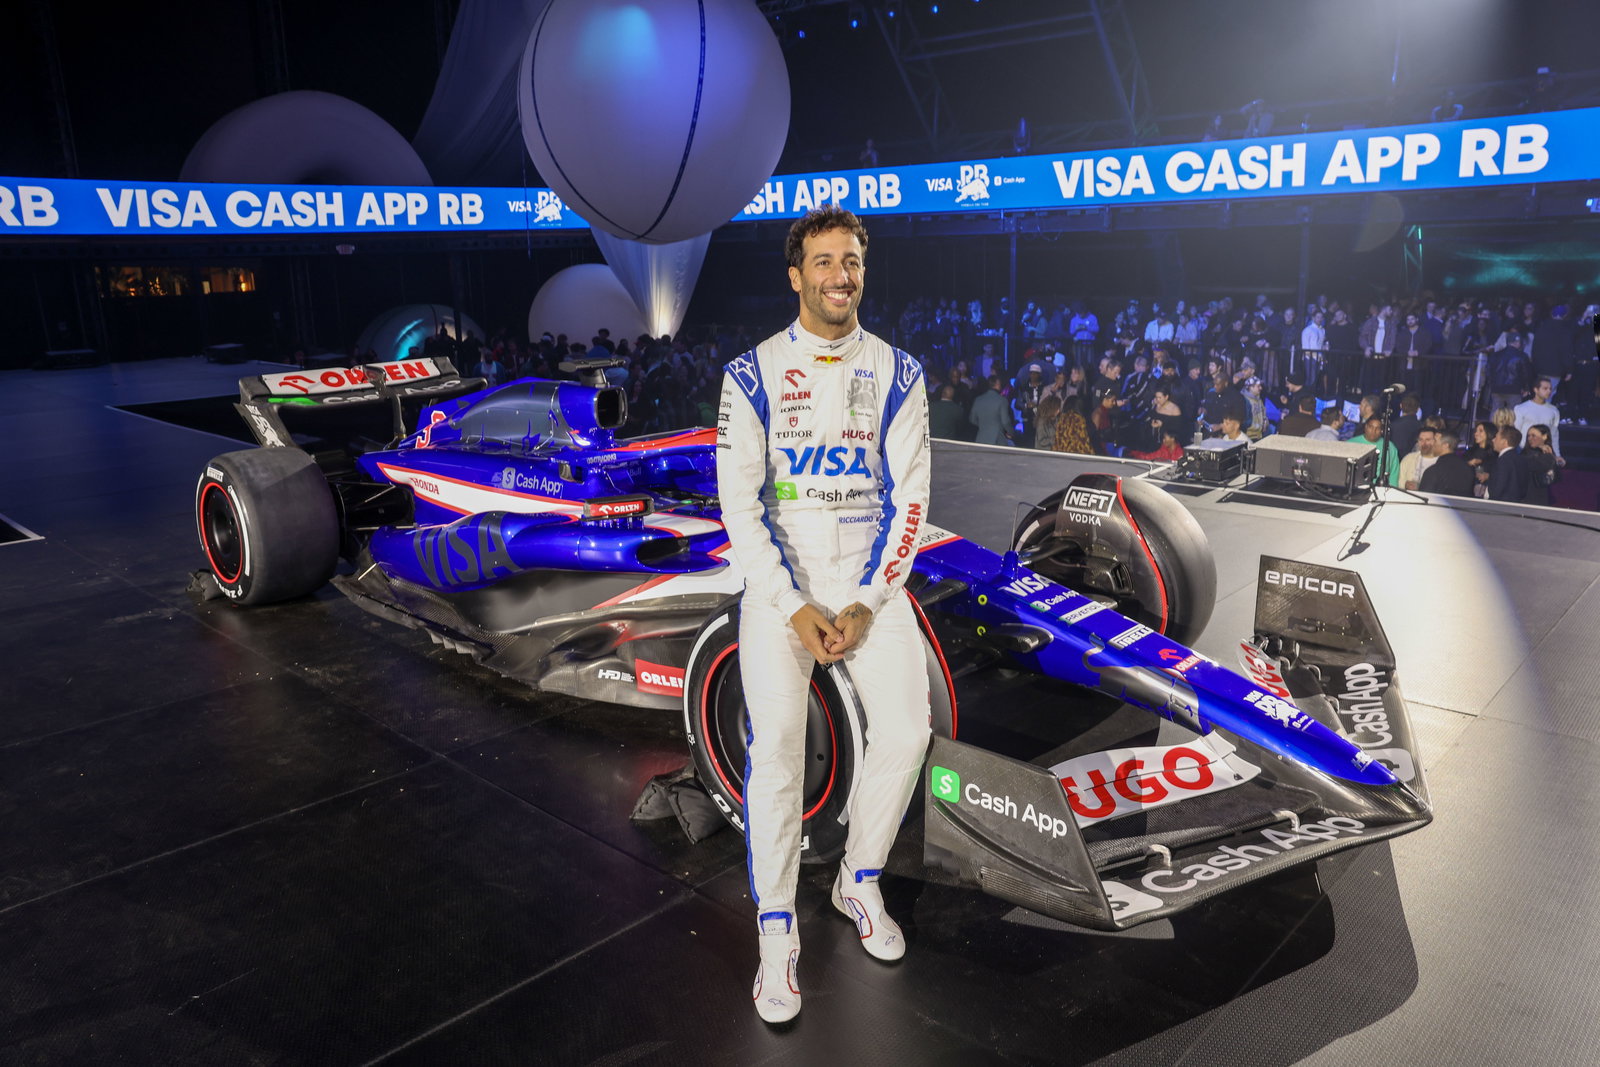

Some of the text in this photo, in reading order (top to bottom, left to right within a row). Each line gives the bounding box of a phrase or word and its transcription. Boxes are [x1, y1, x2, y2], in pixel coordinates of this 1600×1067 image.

[1052, 123, 1550, 199] VISA CASH APP RB
[792, 176, 849, 213] APP
[858, 173, 902, 209] RB
[925, 178, 953, 192] VISA
[96, 187, 485, 228] VISA CASH APP RB
[507, 200, 532, 213] VISA
[854, 368, 875, 380] VISA
[781, 391, 812, 402] RLEN
[775, 429, 813, 439] TUDOR
[842, 428, 874, 441] HUGO
[775, 444, 873, 479] VISA
[516, 472, 539, 490] Cash
[540, 476, 562, 496] App
[806, 487, 842, 502] Cash
[613, 503, 640, 513] ORLEN
[1068, 490, 1109, 510] NEFT
[838, 515, 874, 524] RICCIARDO
[896, 503, 921, 559] ORLEN
[1069, 511, 1102, 527] VODKA
[413, 510, 524, 587] VISA
[1003, 572, 1056, 597] VISA
[1337, 662, 1389, 701] App
[1340, 701, 1393, 748] Cash
[1061, 747, 1214, 819] UGO
[964, 783, 1018, 820] Cash
[1021, 803, 1068, 839] App
[1141, 816, 1365, 893] Cash App
